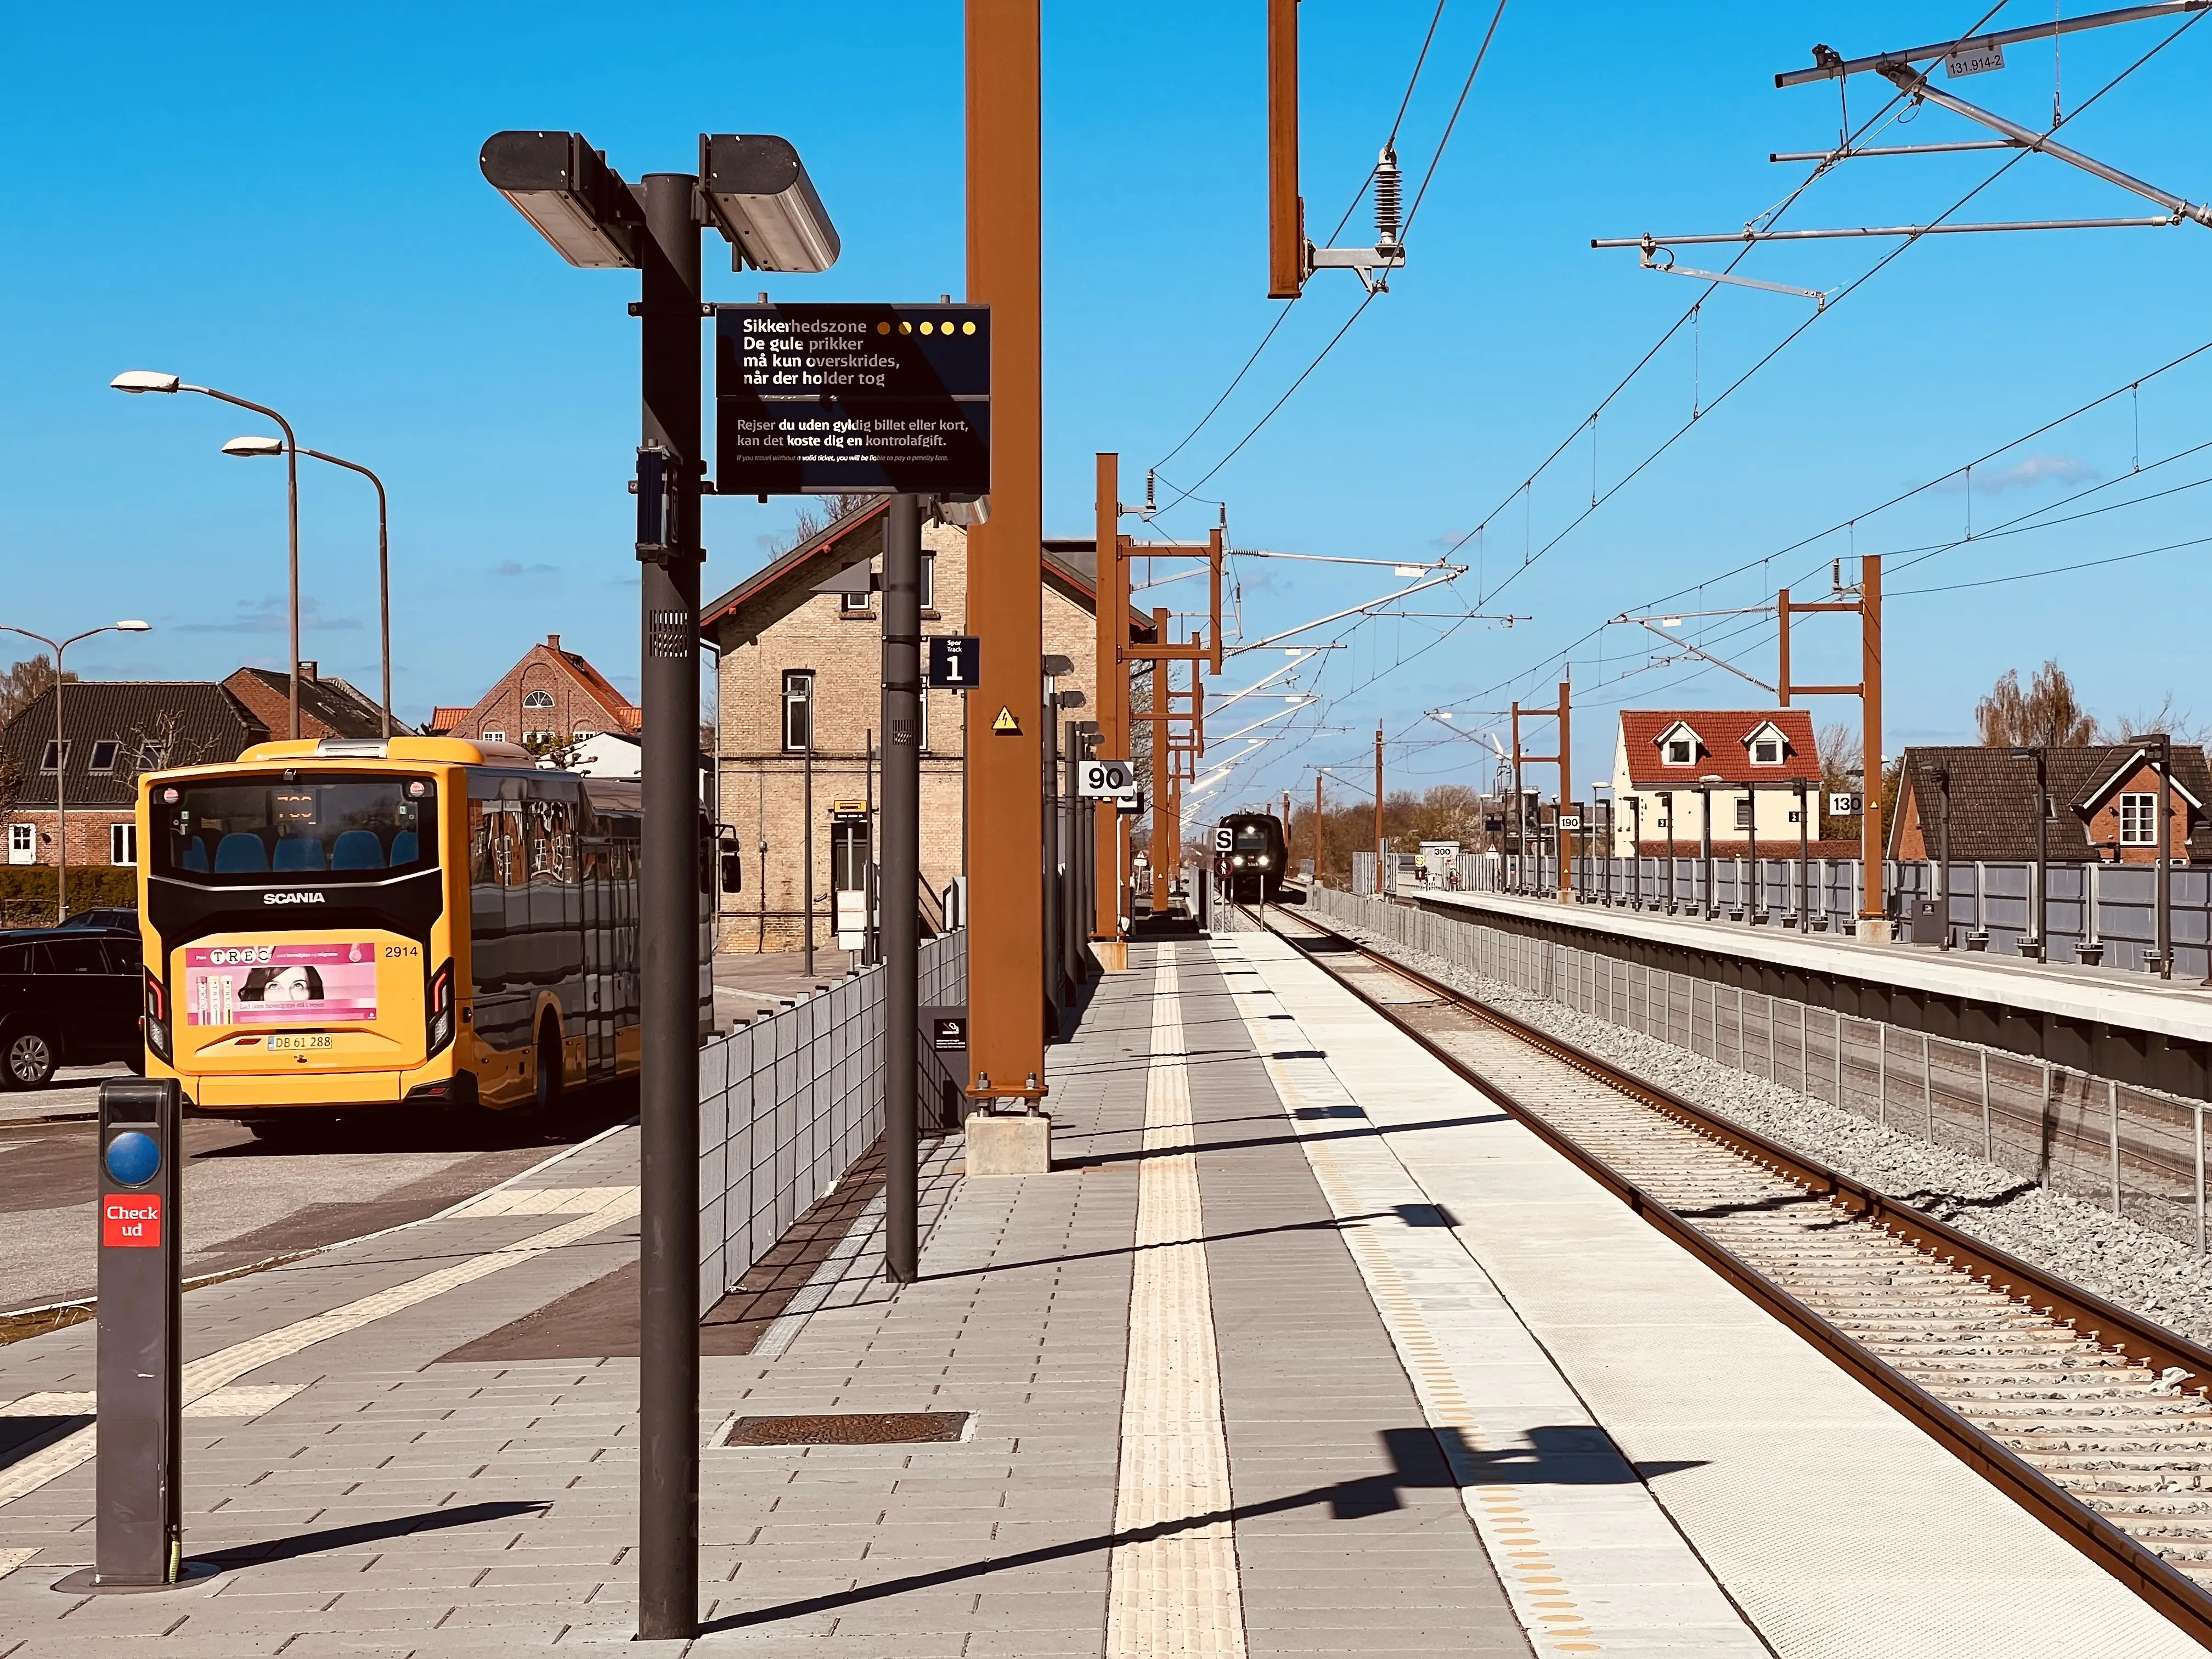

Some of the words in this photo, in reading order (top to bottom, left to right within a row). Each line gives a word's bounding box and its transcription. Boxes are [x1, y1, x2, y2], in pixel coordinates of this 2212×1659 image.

[1950, 55, 2002, 74] 131.914-2
[743, 318, 867, 333] Sikkerhedszone
[744, 336, 765, 350] De
[770, 336, 804, 352] gule
[809, 336, 864, 353] prikker
[743, 353, 768, 367] må
[772, 353, 802, 368] kun
[805, 354, 900, 369] overskrides,
[743, 370, 769, 384] når
[772, 371, 799, 385] der
[803, 371, 854, 385] holder
[858, 373, 885, 387] tog
[737, 419, 776, 432] Rejser
[778, 419, 795, 431] du
[798, 419, 830, 431] uden
[833, 419, 871, 433] gyldig
[874, 419, 906, 431] billet
[909, 419, 936, 431] eller
[940, 419, 968, 432] kort,
[737, 435, 760, 446] kan
[763, 435, 784, 446] det
[787, 435, 821, 447] koste
[823, 435, 844, 448] dig
[847, 437, 862, 446] en
[866, 435, 946, 448] kontrolafgift.
[946, 656, 963, 681] 1
[1088, 768, 1123, 789] 90
[1833, 797, 1861, 811] 130
[1562, 818, 1578, 827] 190
[1216, 830, 1232, 849] S
[1415, 856, 1423, 866] S
[263, 893, 325, 905] SCANIA
[385, 946, 418, 957] 2914
[276, 1037, 290, 1048] DB
[294, 1037, 306, 1047] 61
[310, 1036, 330, 1047] 288
[106, 1206, 159, 1220] Check
[121, 1223, 143, 1237] ud
